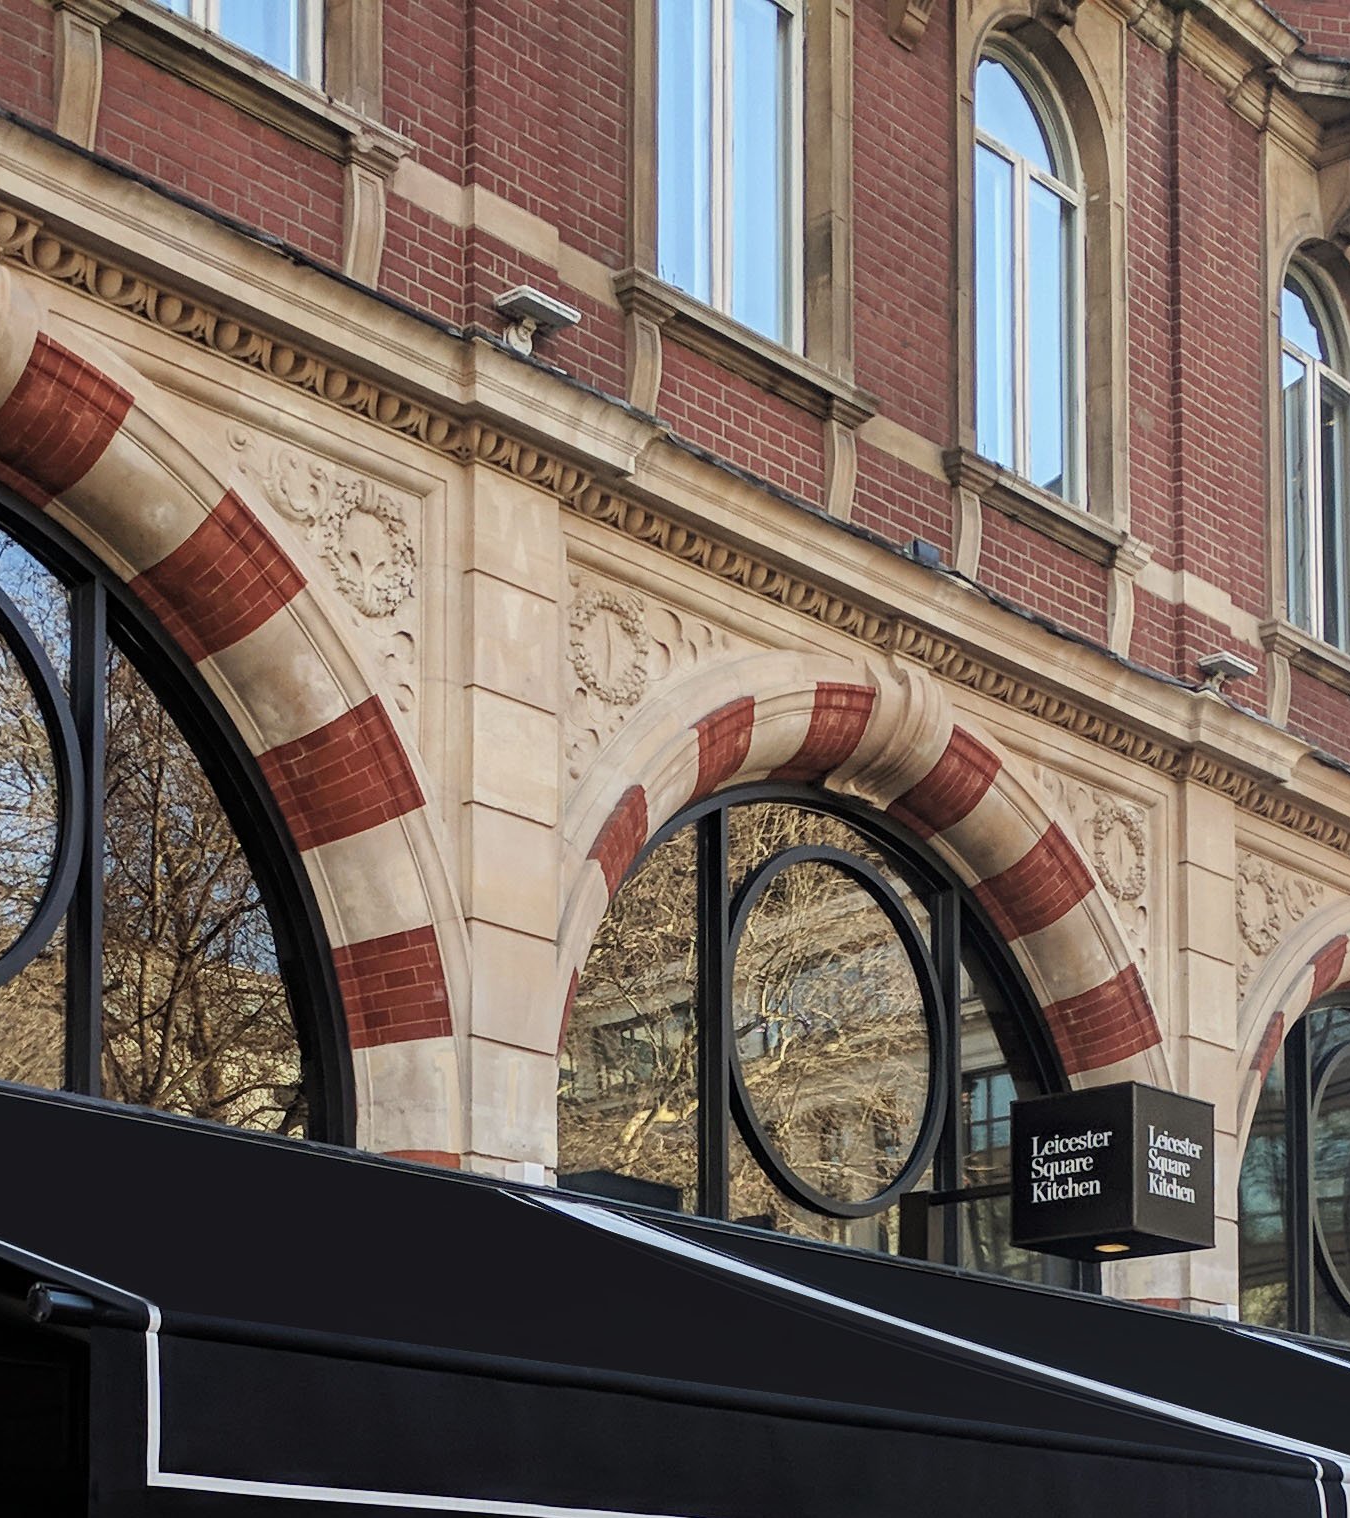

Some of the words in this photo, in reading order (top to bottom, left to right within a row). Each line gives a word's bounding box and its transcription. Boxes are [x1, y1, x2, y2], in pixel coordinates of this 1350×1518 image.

[1031, 1130, 1113, 1158] Leicester
[1147, 1124, 1203, 1160] Leicester
[1031, 1155, 1094, 1182] Square
[1147, 1149, 1191, 1178] Square
[1031, 1178, 1101, 1204] Kitchen
[1147, 1172, 1196, 1204] Kitchen
